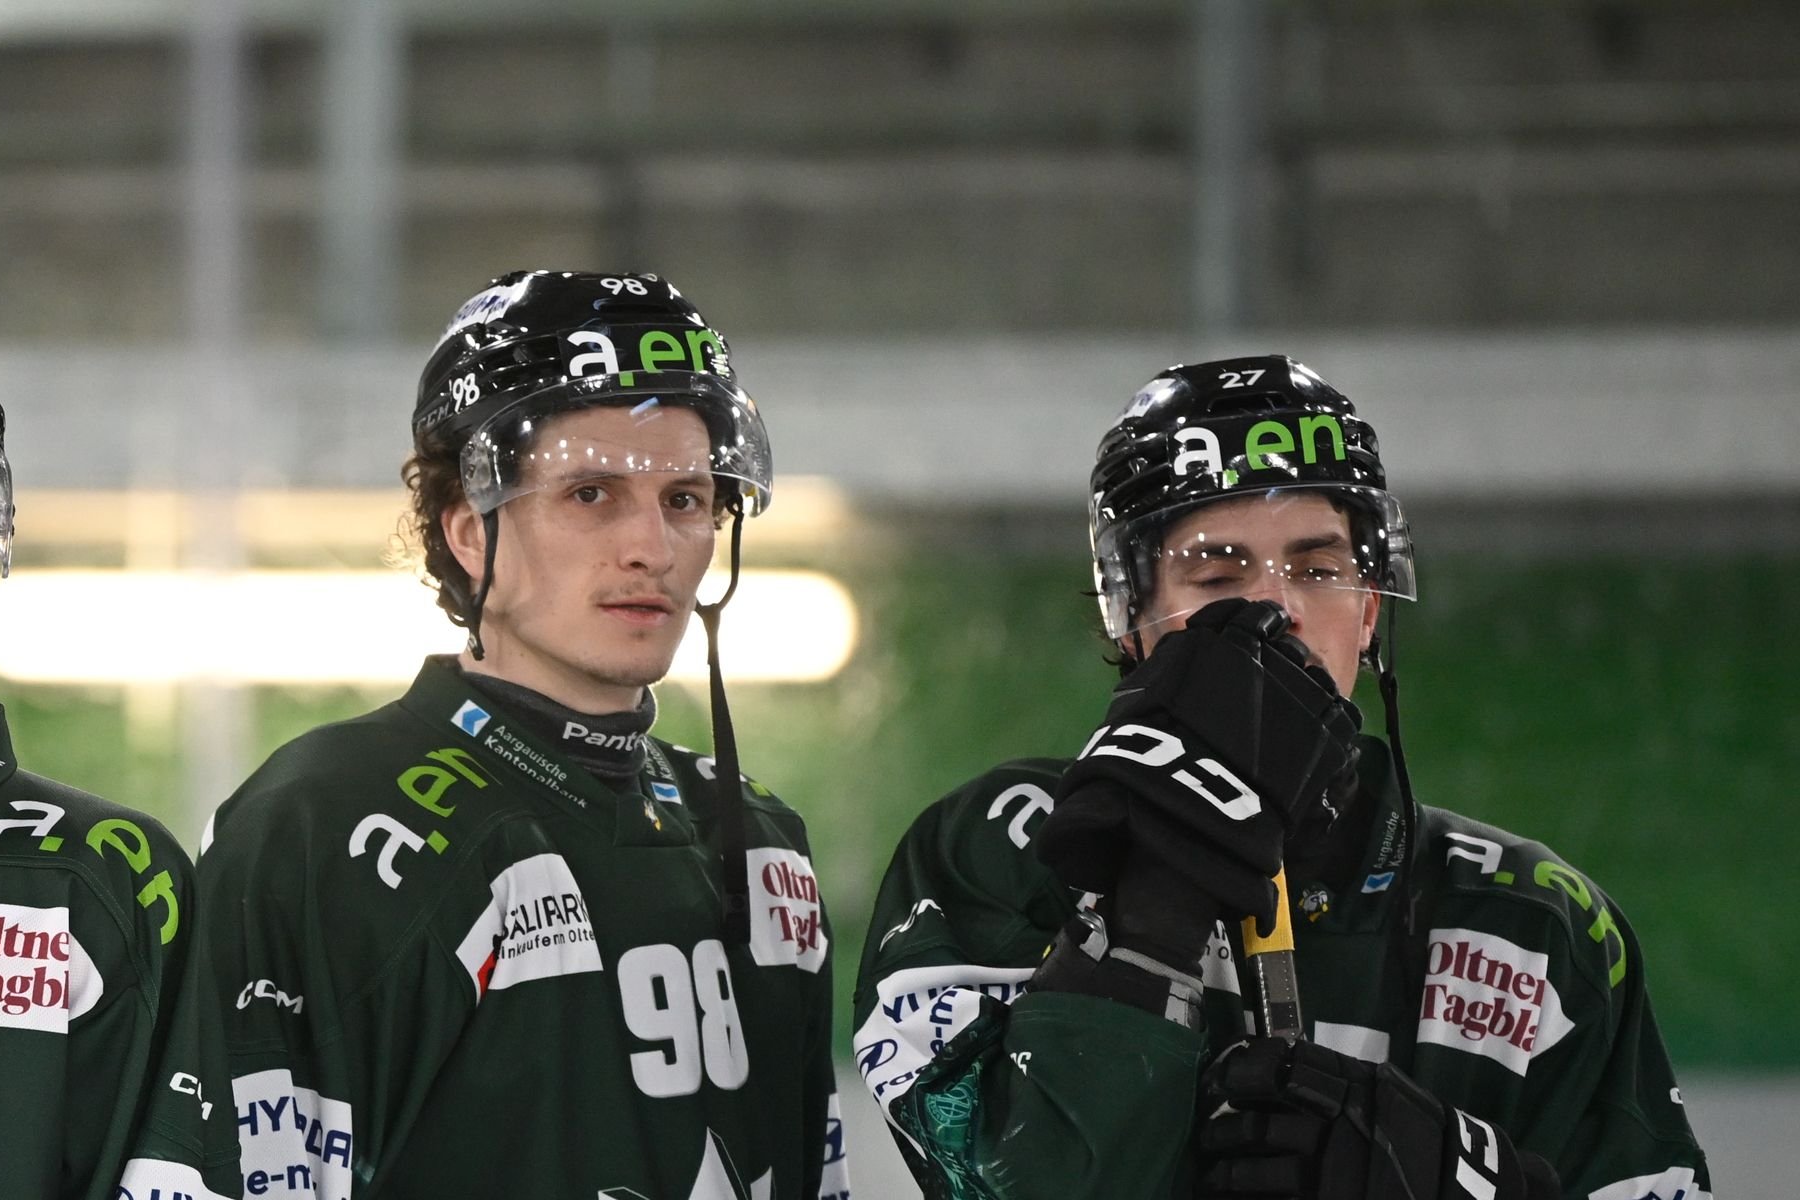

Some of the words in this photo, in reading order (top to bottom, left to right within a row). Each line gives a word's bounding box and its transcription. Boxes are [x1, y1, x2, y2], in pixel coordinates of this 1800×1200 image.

[601, 277, 648, 296] 98
[452, 373, 481, 414] 98
[1218, 369, 1266, 389] 27
[1173, 414, 1347, 485] a.en
[484, 735, 587, 809] Kantonalbank
[493, 725, 568, 781] Aargauische
[616, 938, 750, 1099] 98
